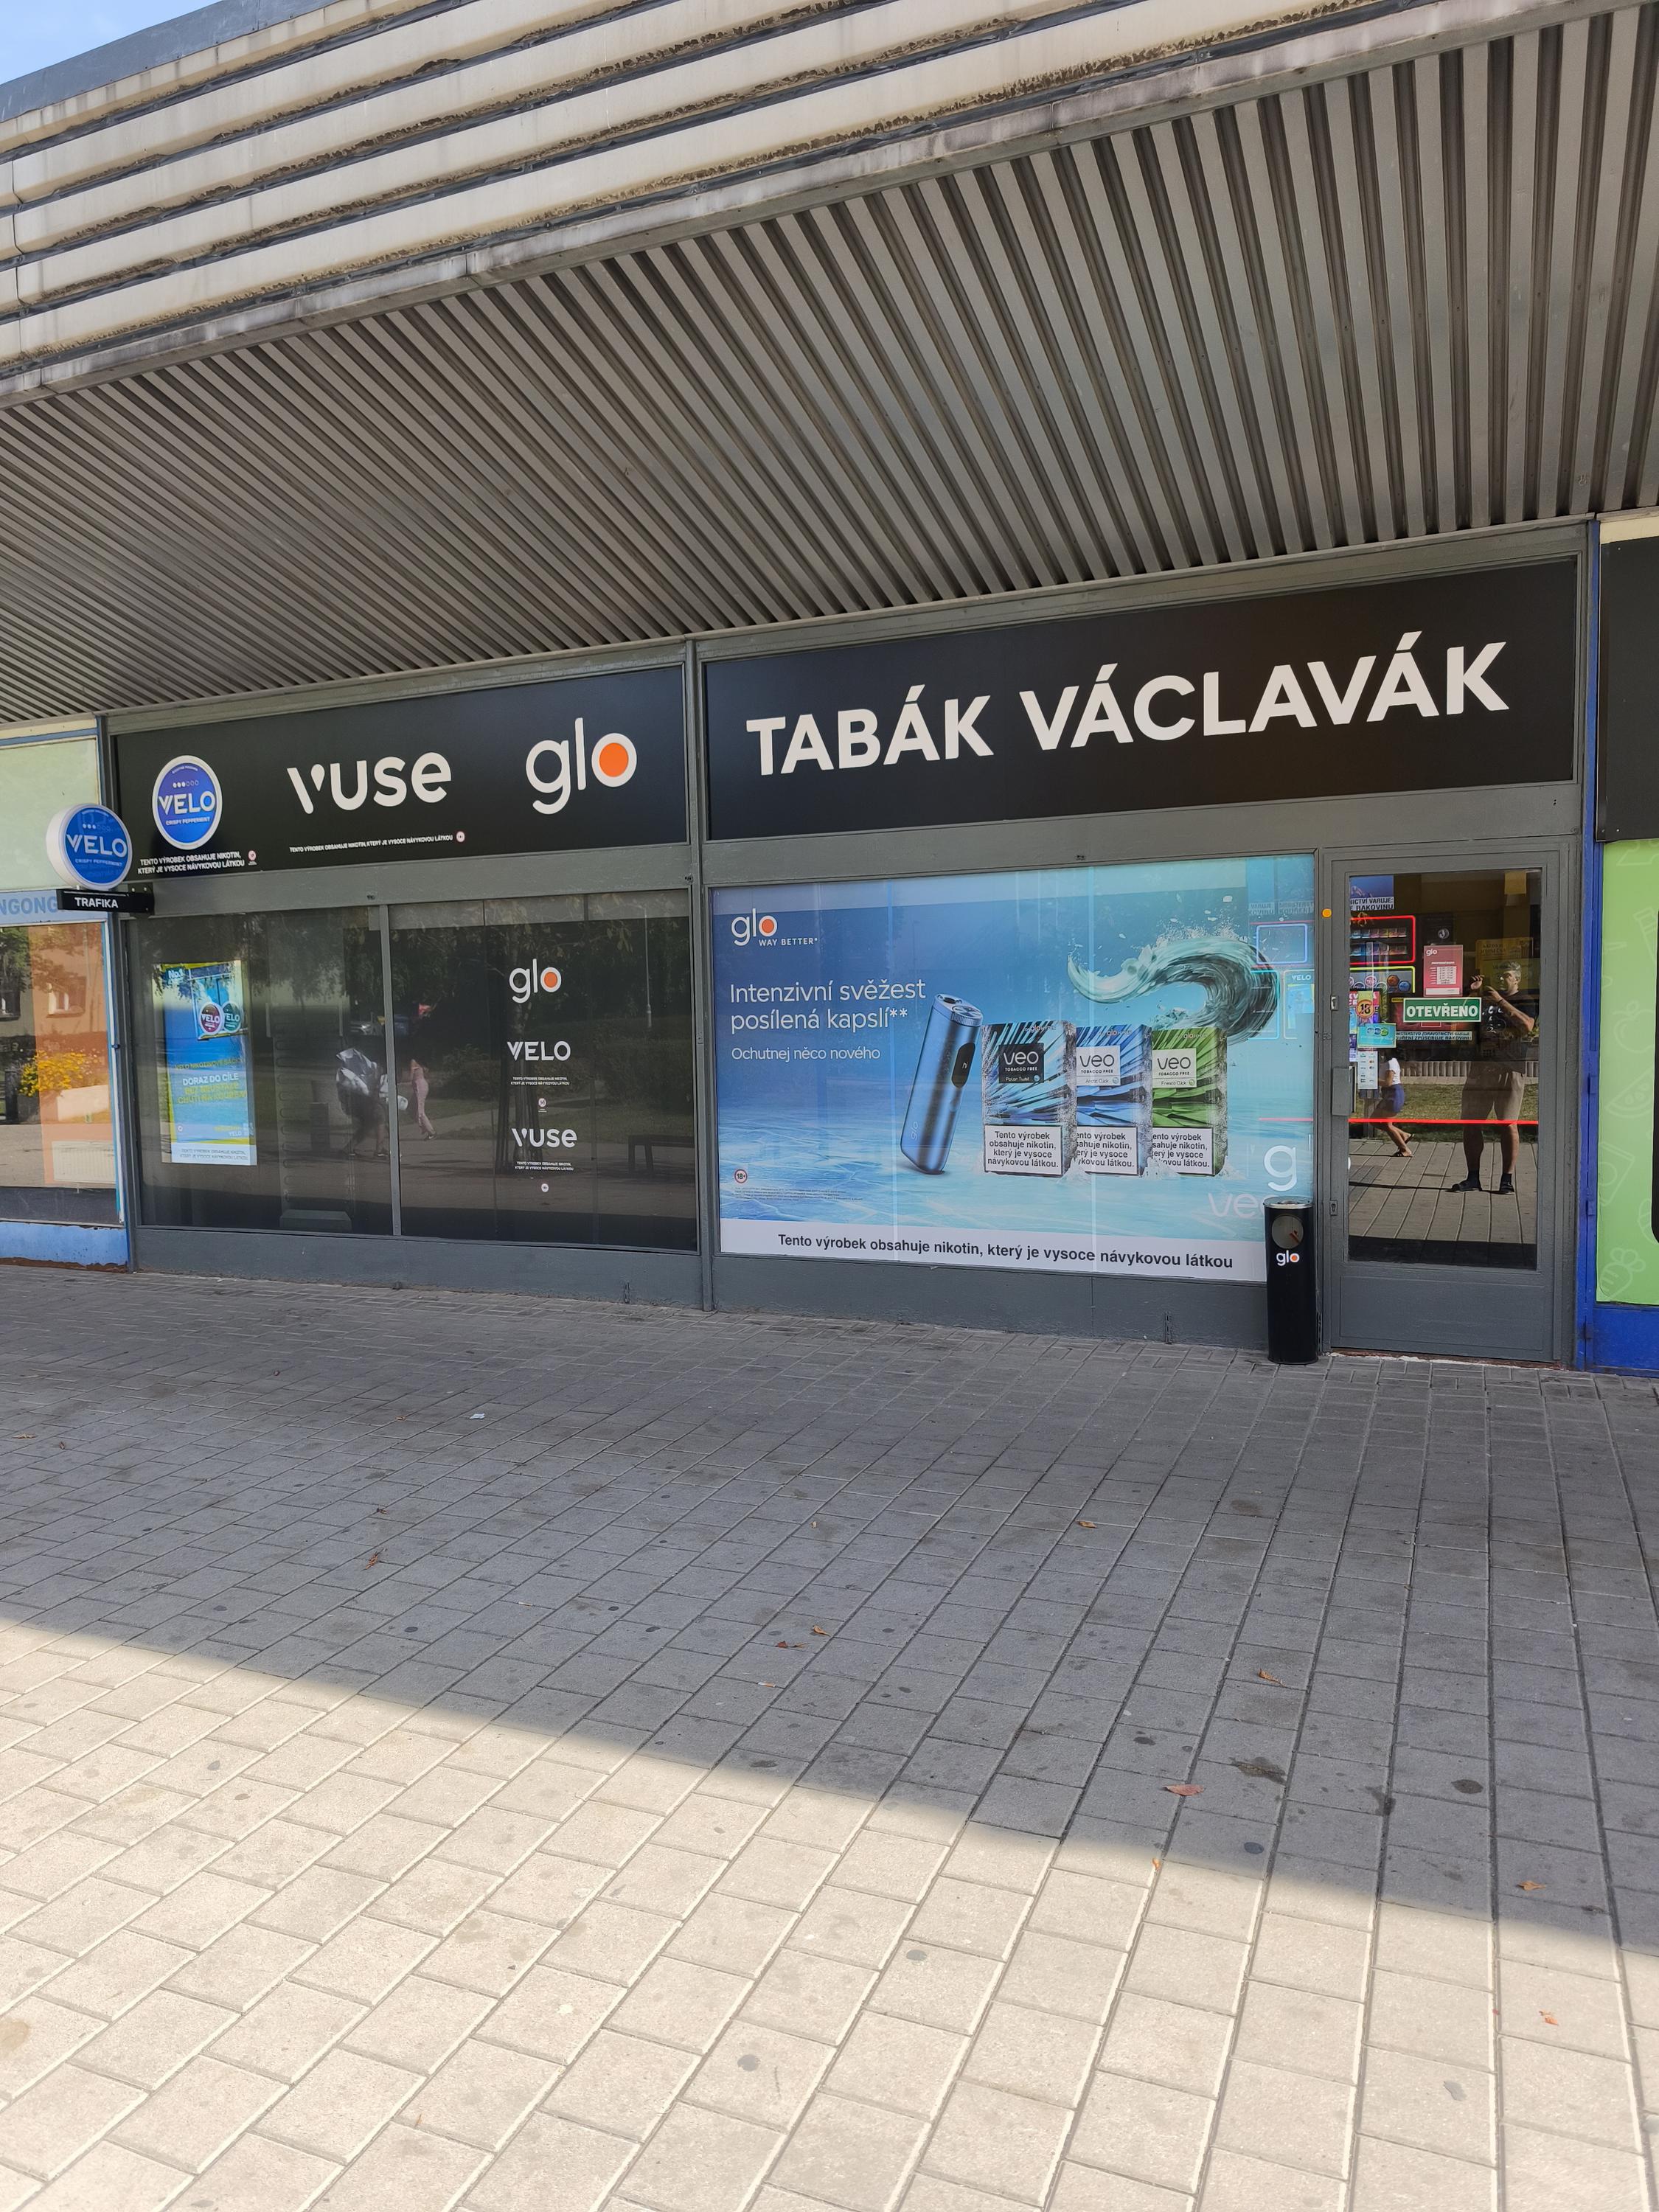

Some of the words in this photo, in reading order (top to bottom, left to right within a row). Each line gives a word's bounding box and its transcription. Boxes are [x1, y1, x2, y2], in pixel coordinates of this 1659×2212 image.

[746, 684, 994, 776] TABÁK
[1020, 630, 1510, 751] VÁCLAVÁK
[525, 717, 638, 815] glo
[158, 790, 216, 815] VELO
[66, 834, 128, 858] VELO
[140, 858, 159, 866] TENTO
[159, 855, 185, 864] VÝROBEK
[186, 853, 216, 862] OBSAHUJE
[217, 851, 242, 860] NIKOTIN,
[164, 863, 187, 872] VYSOCE
[187, 860, 221, 871] NÁVYKOVOU
[222, 858, 245, 868] LÁTKOU
[74, 897, 119, 908] TRAFIKA
[731, 908, 778, 947] glo
[758, 939, 778, 947] WAY
[1426, 948, 1438, 956] glo
[509, 959, 562, 1004] glo
[730, 980, 833, 1003] Intenzivní
[839, 978, 926, 1001] svěžest
[1360, 1004, 1371, 1014] 18
[1407, 1003, 1478, 1018] OTEVŘENO
[731, 1008, 820, 1034] posílená
[507, 1040, 571, 1061] VELO
[731, 1047, 790, 1062] Ochutnej
[793, 1046, 827, 1060] něco
[830, 1046, 881, 1060] nového
[1003, 1051, 1040, 1065] veo
[1079, 1054, 1116, 1068] veo
[1157, 1057, 1192, 1070] veo
[182, 1077, 209, 1086] DORAZ
[209, 1075, 221, 1083] DO
[222, 1071, 240, 1082] CÍLE
[1018, 1132, 1051, 1141] výrobek
[1094, 1133, 1126, 1141] výrobek
[1171, 1134, 1202, 1142] výrobek
[989, 1141, 1025, 1149] obsahuje
[1026, 1141, 1057, 1150] nikotin,
[1077, 1142, 1101, 1150] sahuje
[993, 1150, 1013, 1158] který
[987, 1158, 1029, 1166] návykovou
[1032, 1159, 1059, 1167] látkou.
[1107, 1159, 1135, 1167] látkou.
[1183, 1160, 1210, 1168] látkou.
[779, 1234, 812, 1248] Tento
[815, 1236, 866, 1251] výrobek
[870, 1239, 930, 1254] obsahuje
[934, 1242, 984, 1258] nikotin,
[987, 1245, 1022, 1259] který
[1026, 1245, 1040, 1259] je
[1043, 1248, 1096, 1262] vysoce
[1100, 1250, 1181, 1267] návykovou
[1186, 1255, 1233, 1269] látkou
[1276, 1250, 1300, 1267] glo
